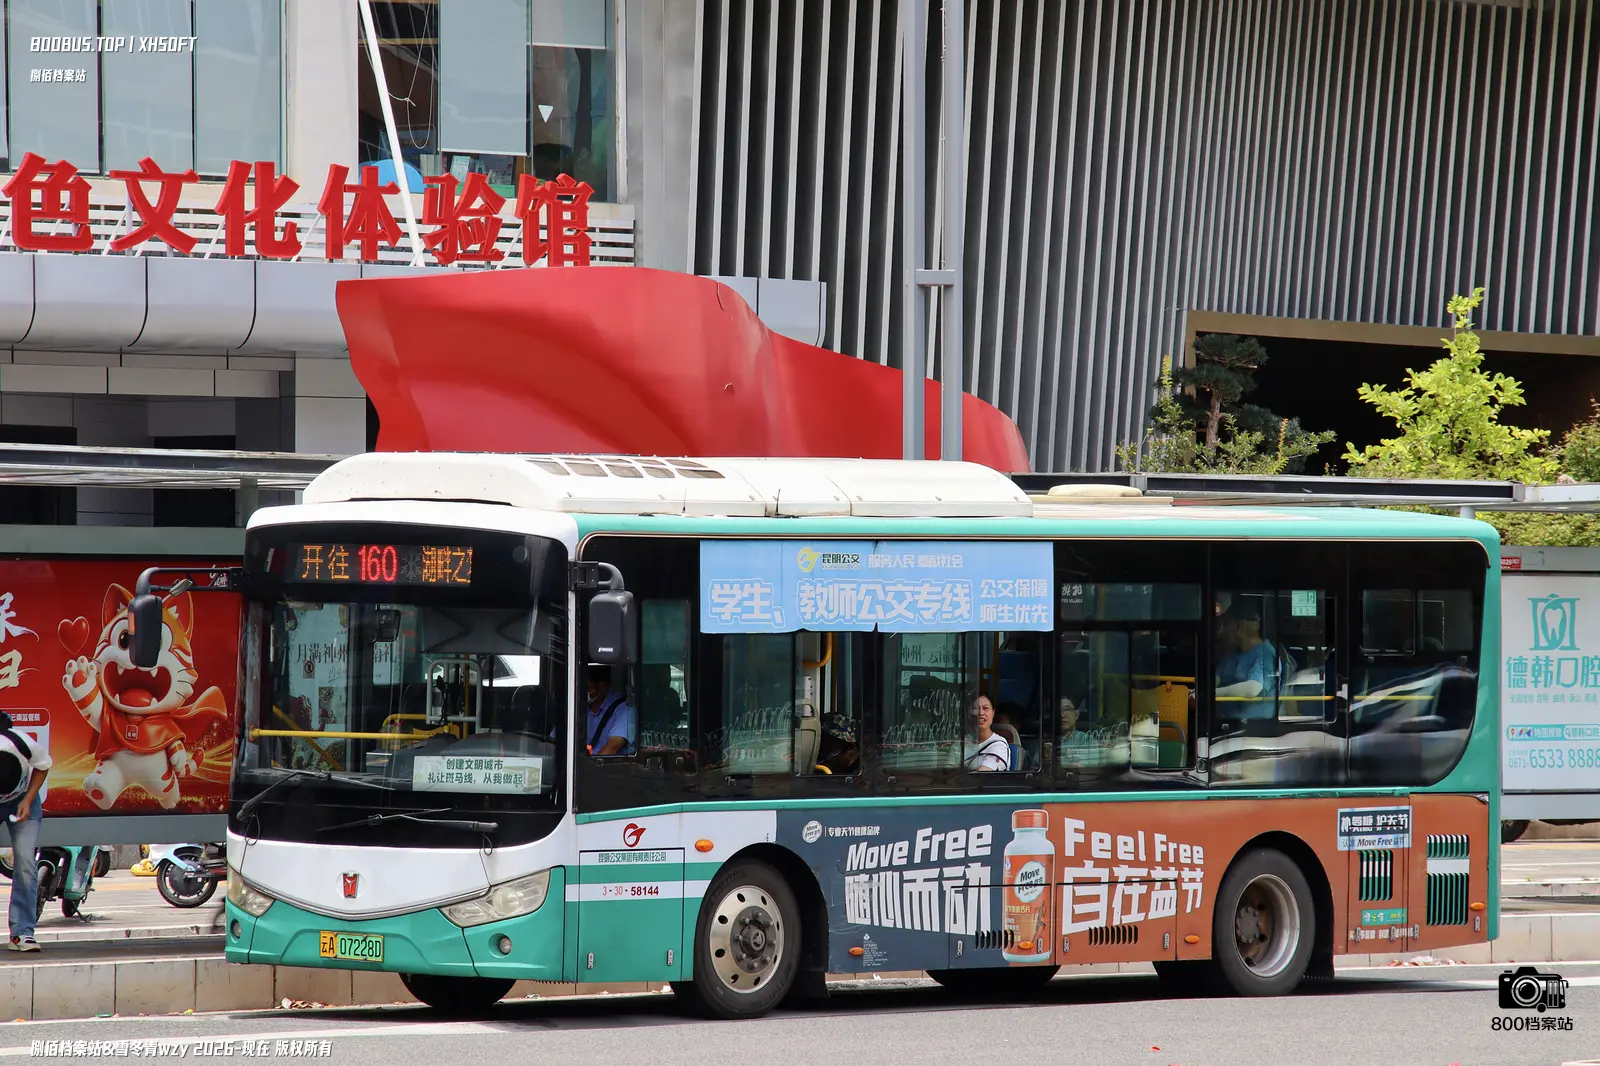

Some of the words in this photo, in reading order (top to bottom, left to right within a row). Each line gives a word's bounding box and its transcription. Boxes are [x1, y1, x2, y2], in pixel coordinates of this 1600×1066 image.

[3, 152, 594, 267] 色文化体验馆
[302, 545, 350, 579] 开往
[358, 545, 397, 581] 160
[822, 553, 860, 564] 昆明公交
[868, 554, 915, 568] 服务人民
[980, 579, 1049, 598] 公交保障
[980, 605, 1049, 623] 师生优先
[1506, 656, 1600, 689] 德韩口腔
[446, 759, 504, 770] 创建文明城市
[846, 840, 909, 872] Move
[913, 824, 993, 864] Free
[1064, 817, 1147, 862] Feel
[1154, 833, 1204, 865] Free
[1357, 837, 1377, 847] Move
[1377, 836, 1393, 846] Free
[1020, 868, 1040, 882] Move
[844, 862, 992, 937] 随心而动
[1062, 860, 1204, 935] 自在益节
